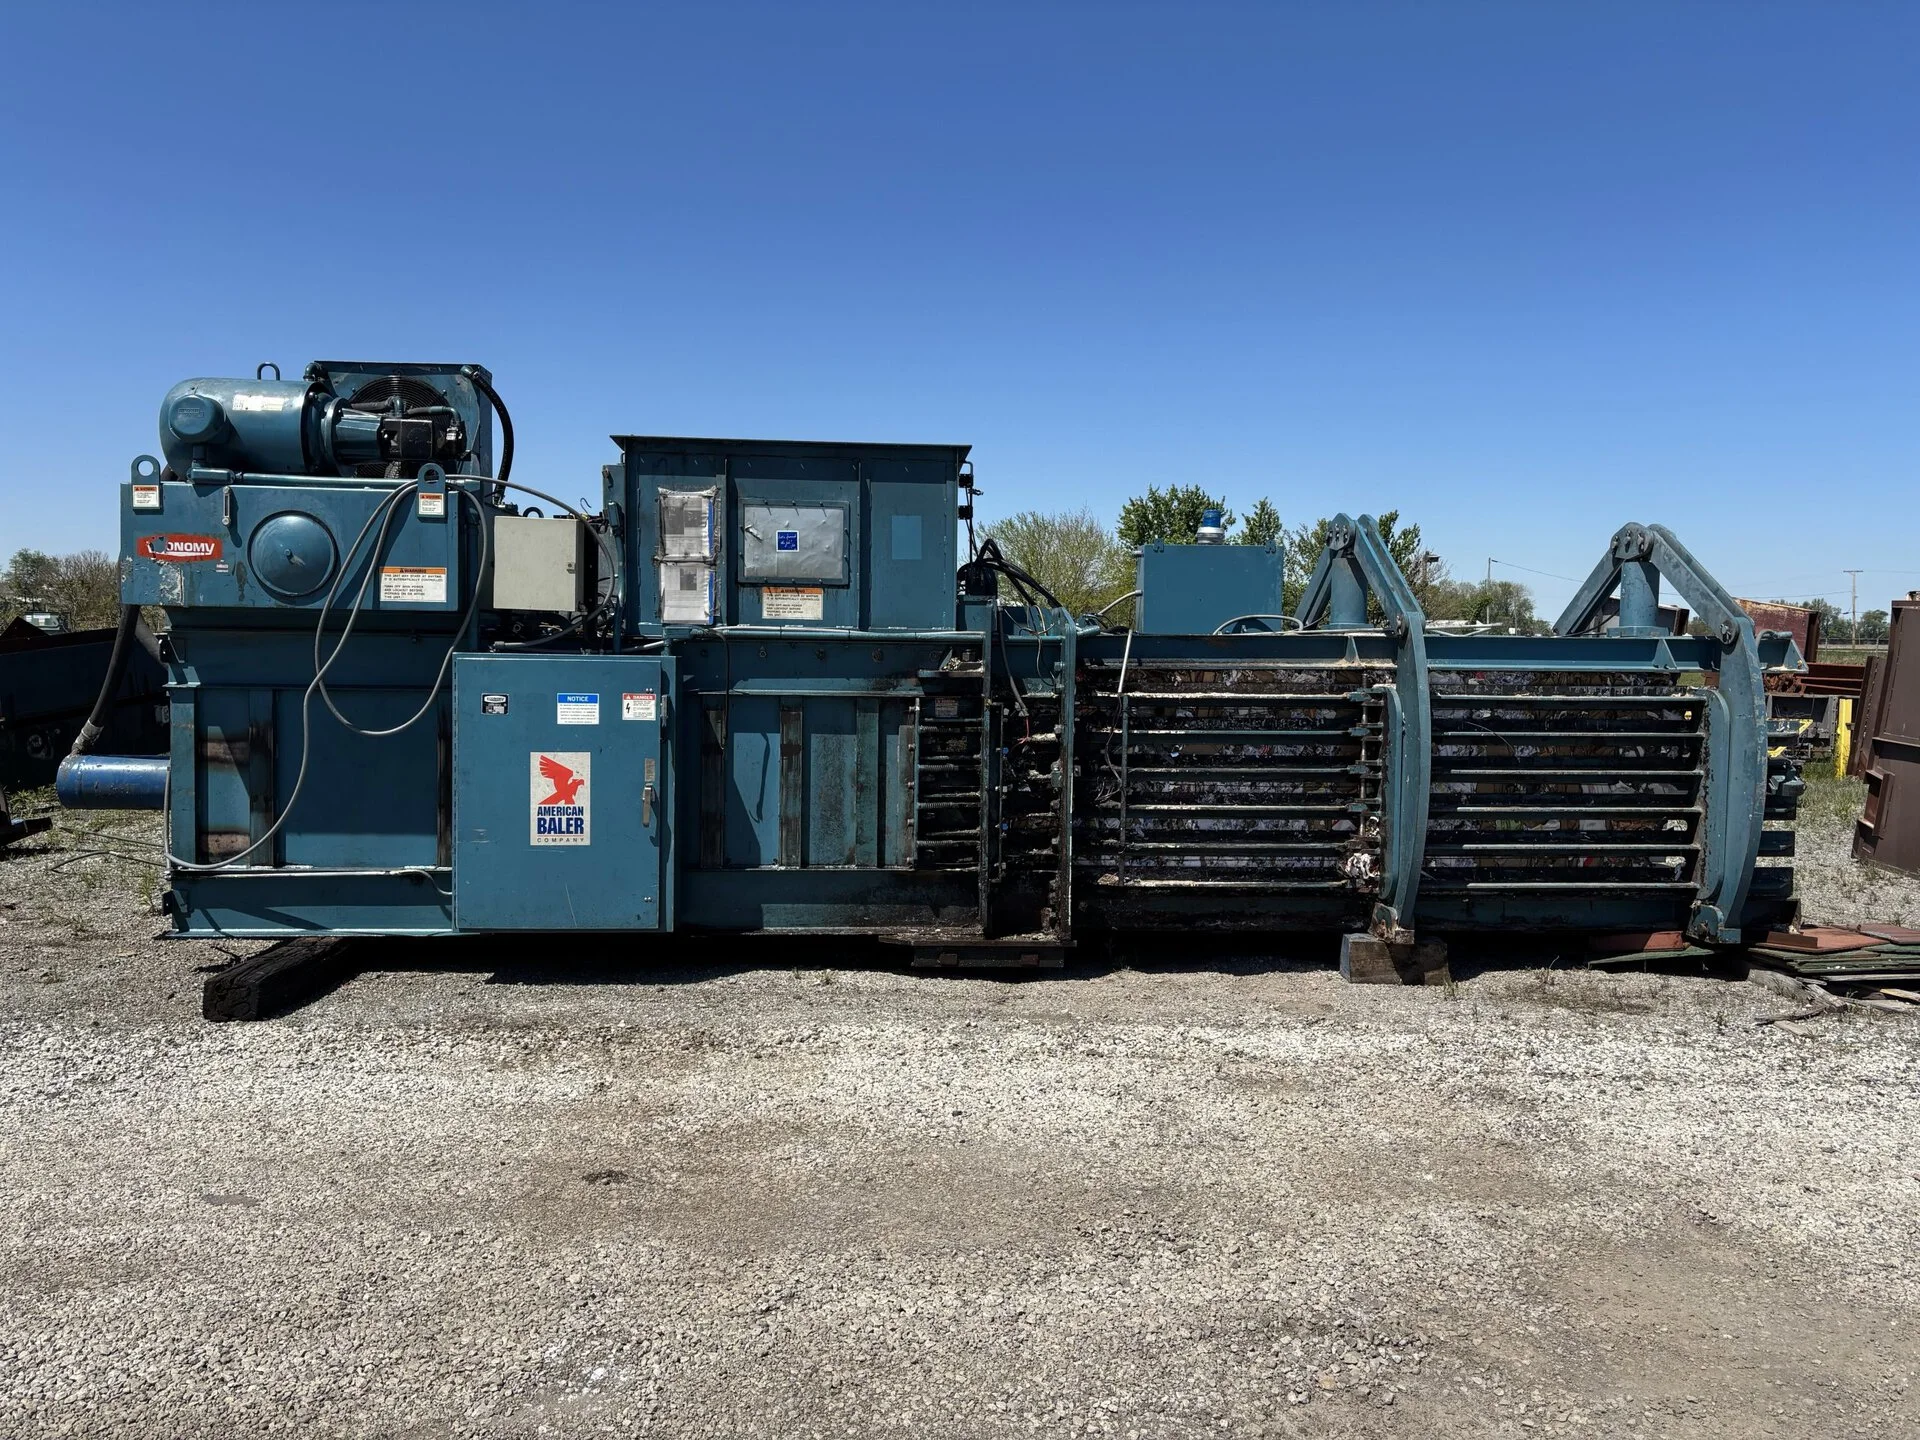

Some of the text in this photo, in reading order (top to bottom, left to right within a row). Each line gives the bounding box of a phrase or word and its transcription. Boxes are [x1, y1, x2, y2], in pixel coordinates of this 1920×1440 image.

[147, 542, 214, 556] ONOMY
[537, 806, 584, 816] AMERICAN
[537, 817, 584, 834] BALER
